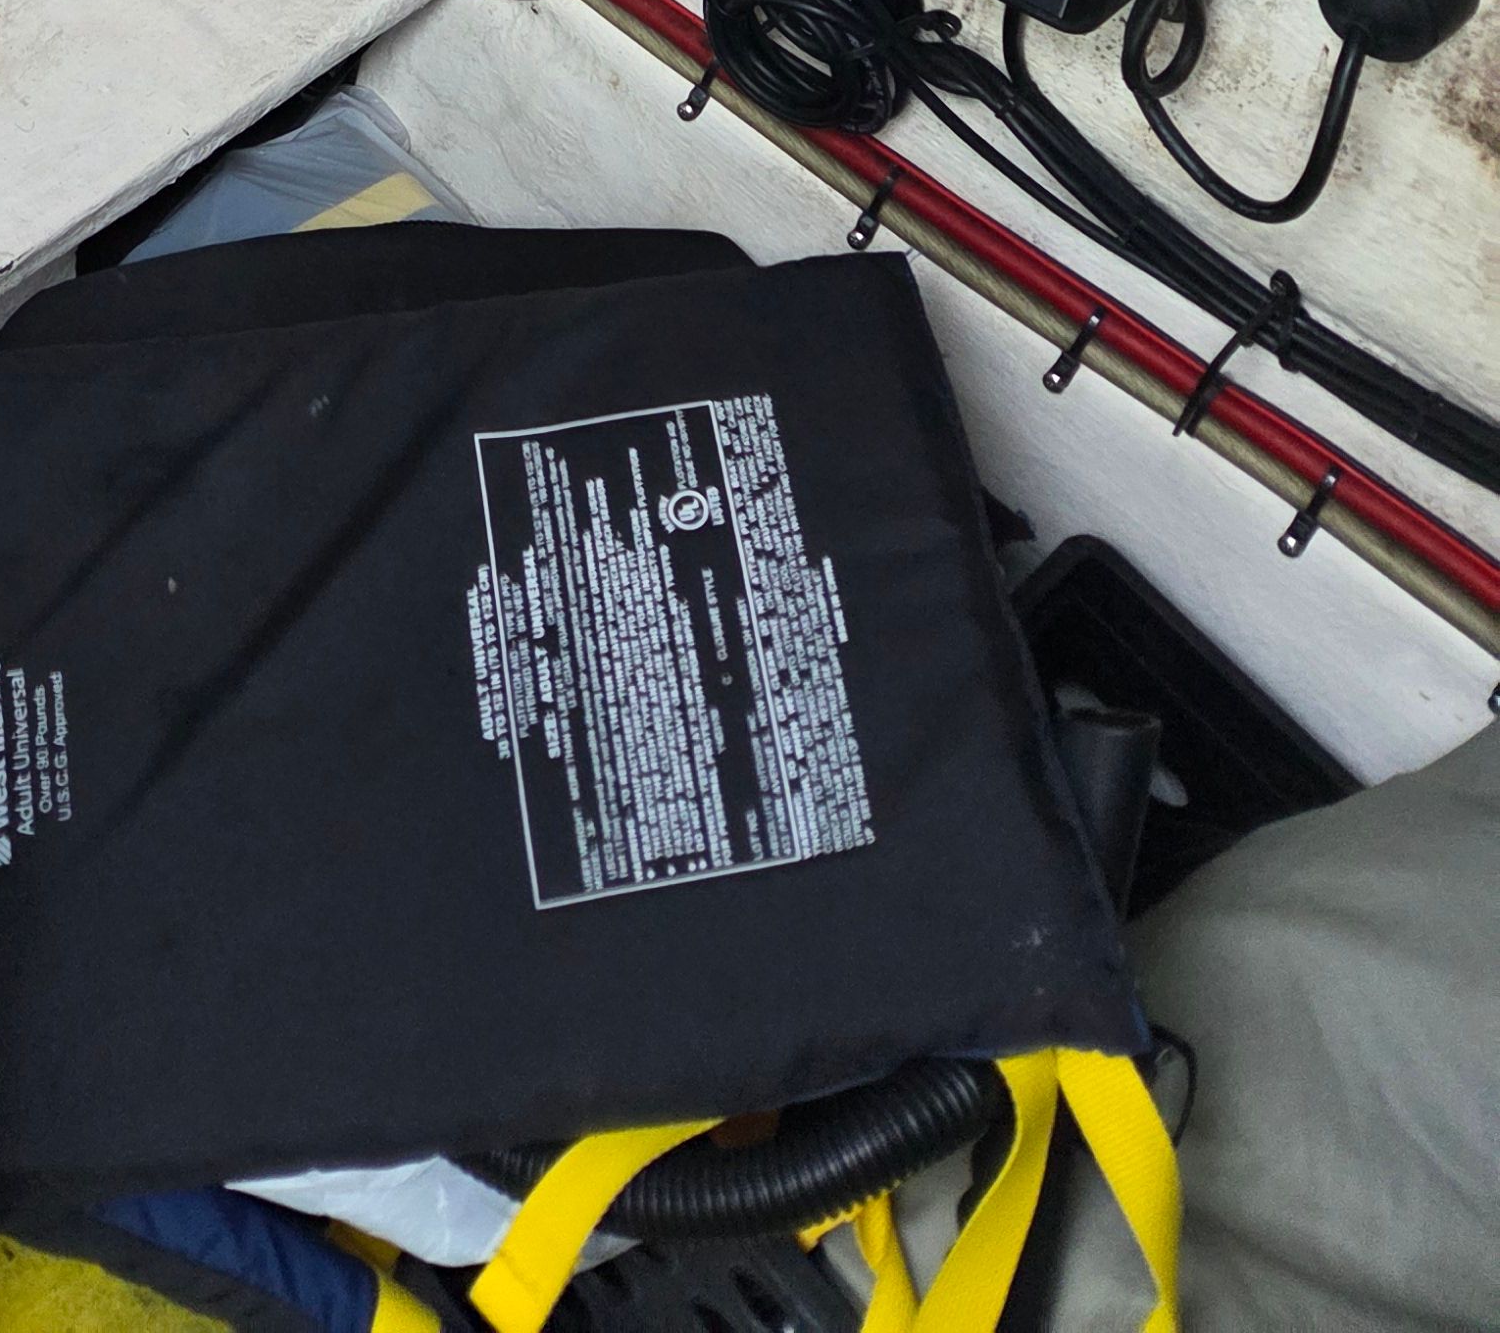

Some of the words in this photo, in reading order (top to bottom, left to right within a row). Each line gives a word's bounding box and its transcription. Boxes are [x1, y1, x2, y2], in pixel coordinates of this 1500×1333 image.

[466, 584, 487, 679] UNIVERSAL
[5, 667, 30, 770] Universal
[32, 684, 48, 746] Pounds
[49, 671, 68, 746] Approved
[476, 683, 494, 740] ADULT
[35, 750, 49, 769] 90
[13, 772, 34, 835] Adult
[38, 771, 52, 813] Over
